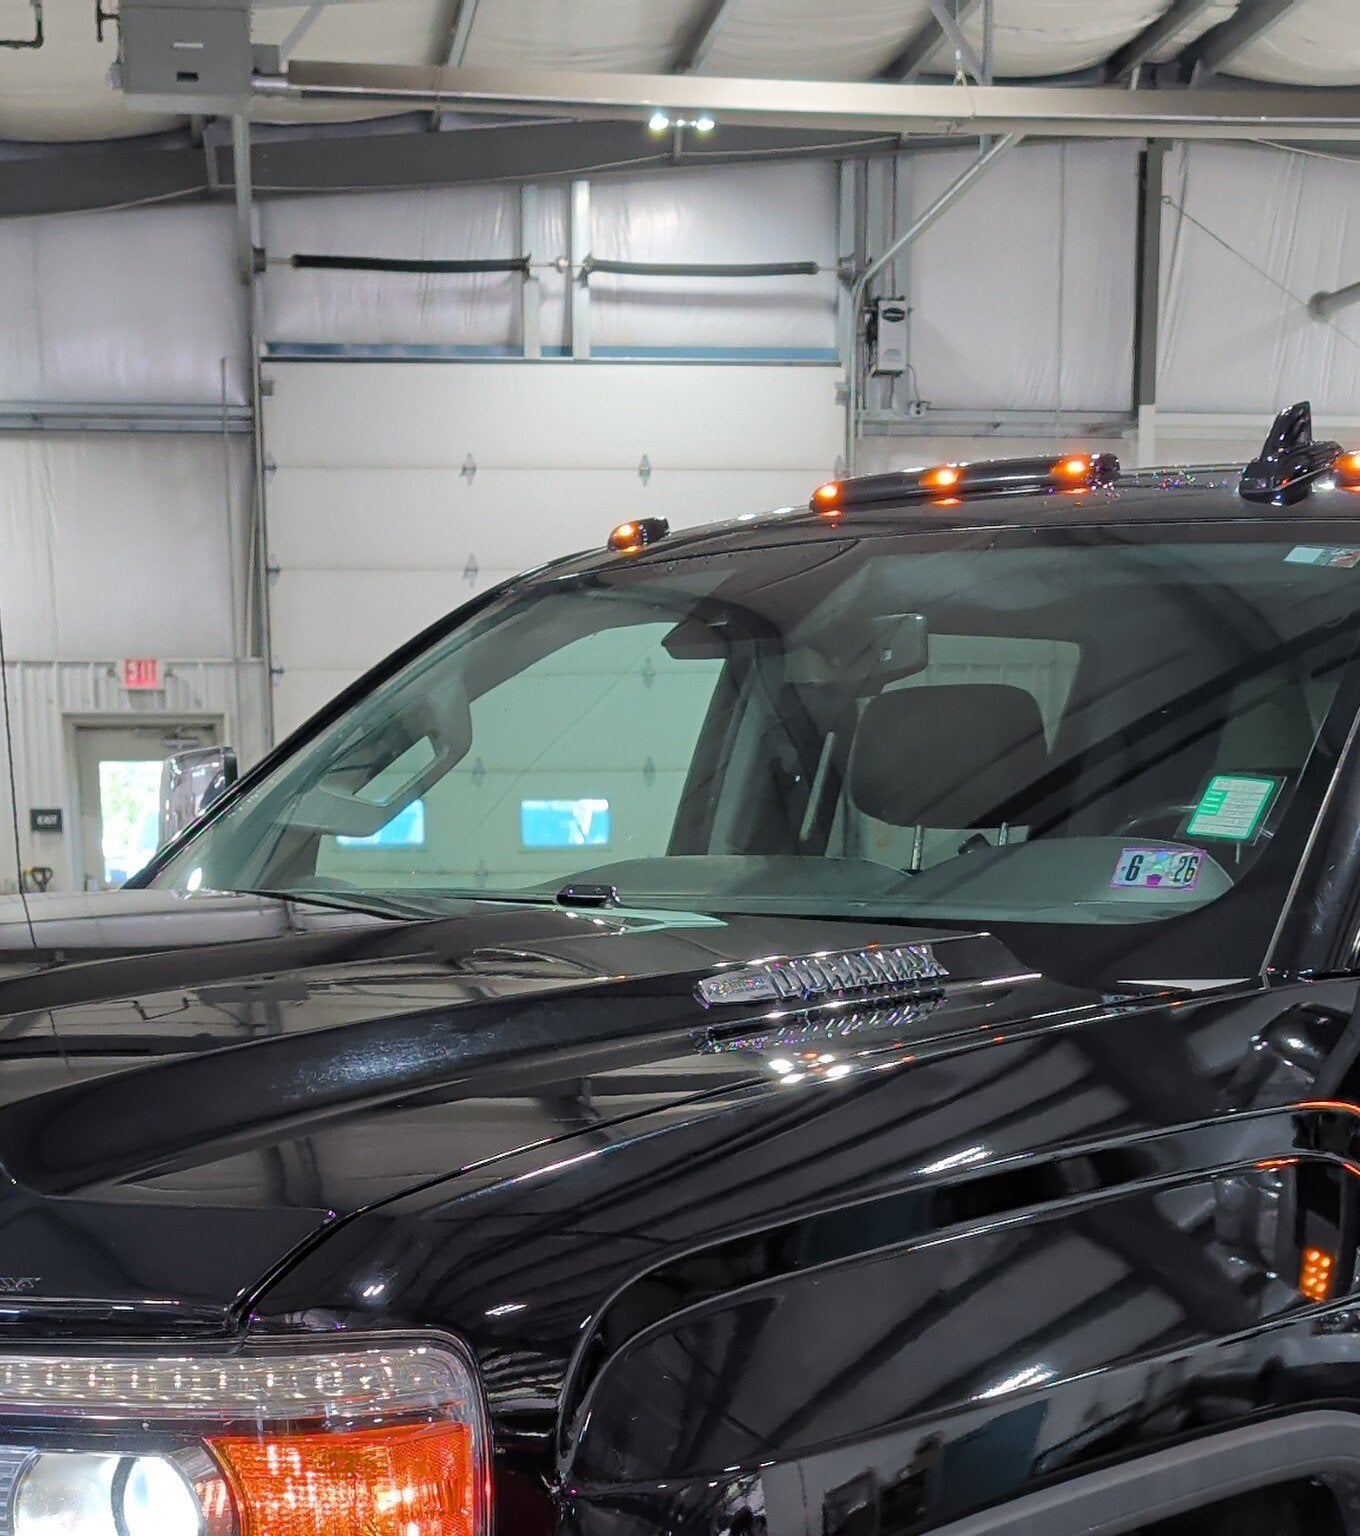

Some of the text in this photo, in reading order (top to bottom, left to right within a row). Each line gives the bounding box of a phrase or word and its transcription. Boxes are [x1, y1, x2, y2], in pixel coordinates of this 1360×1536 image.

[125, 660, 157, 687] EXIT
[1173, 855, 1199, 883] 26
[763, 945, 949, 999] DURAMAX
